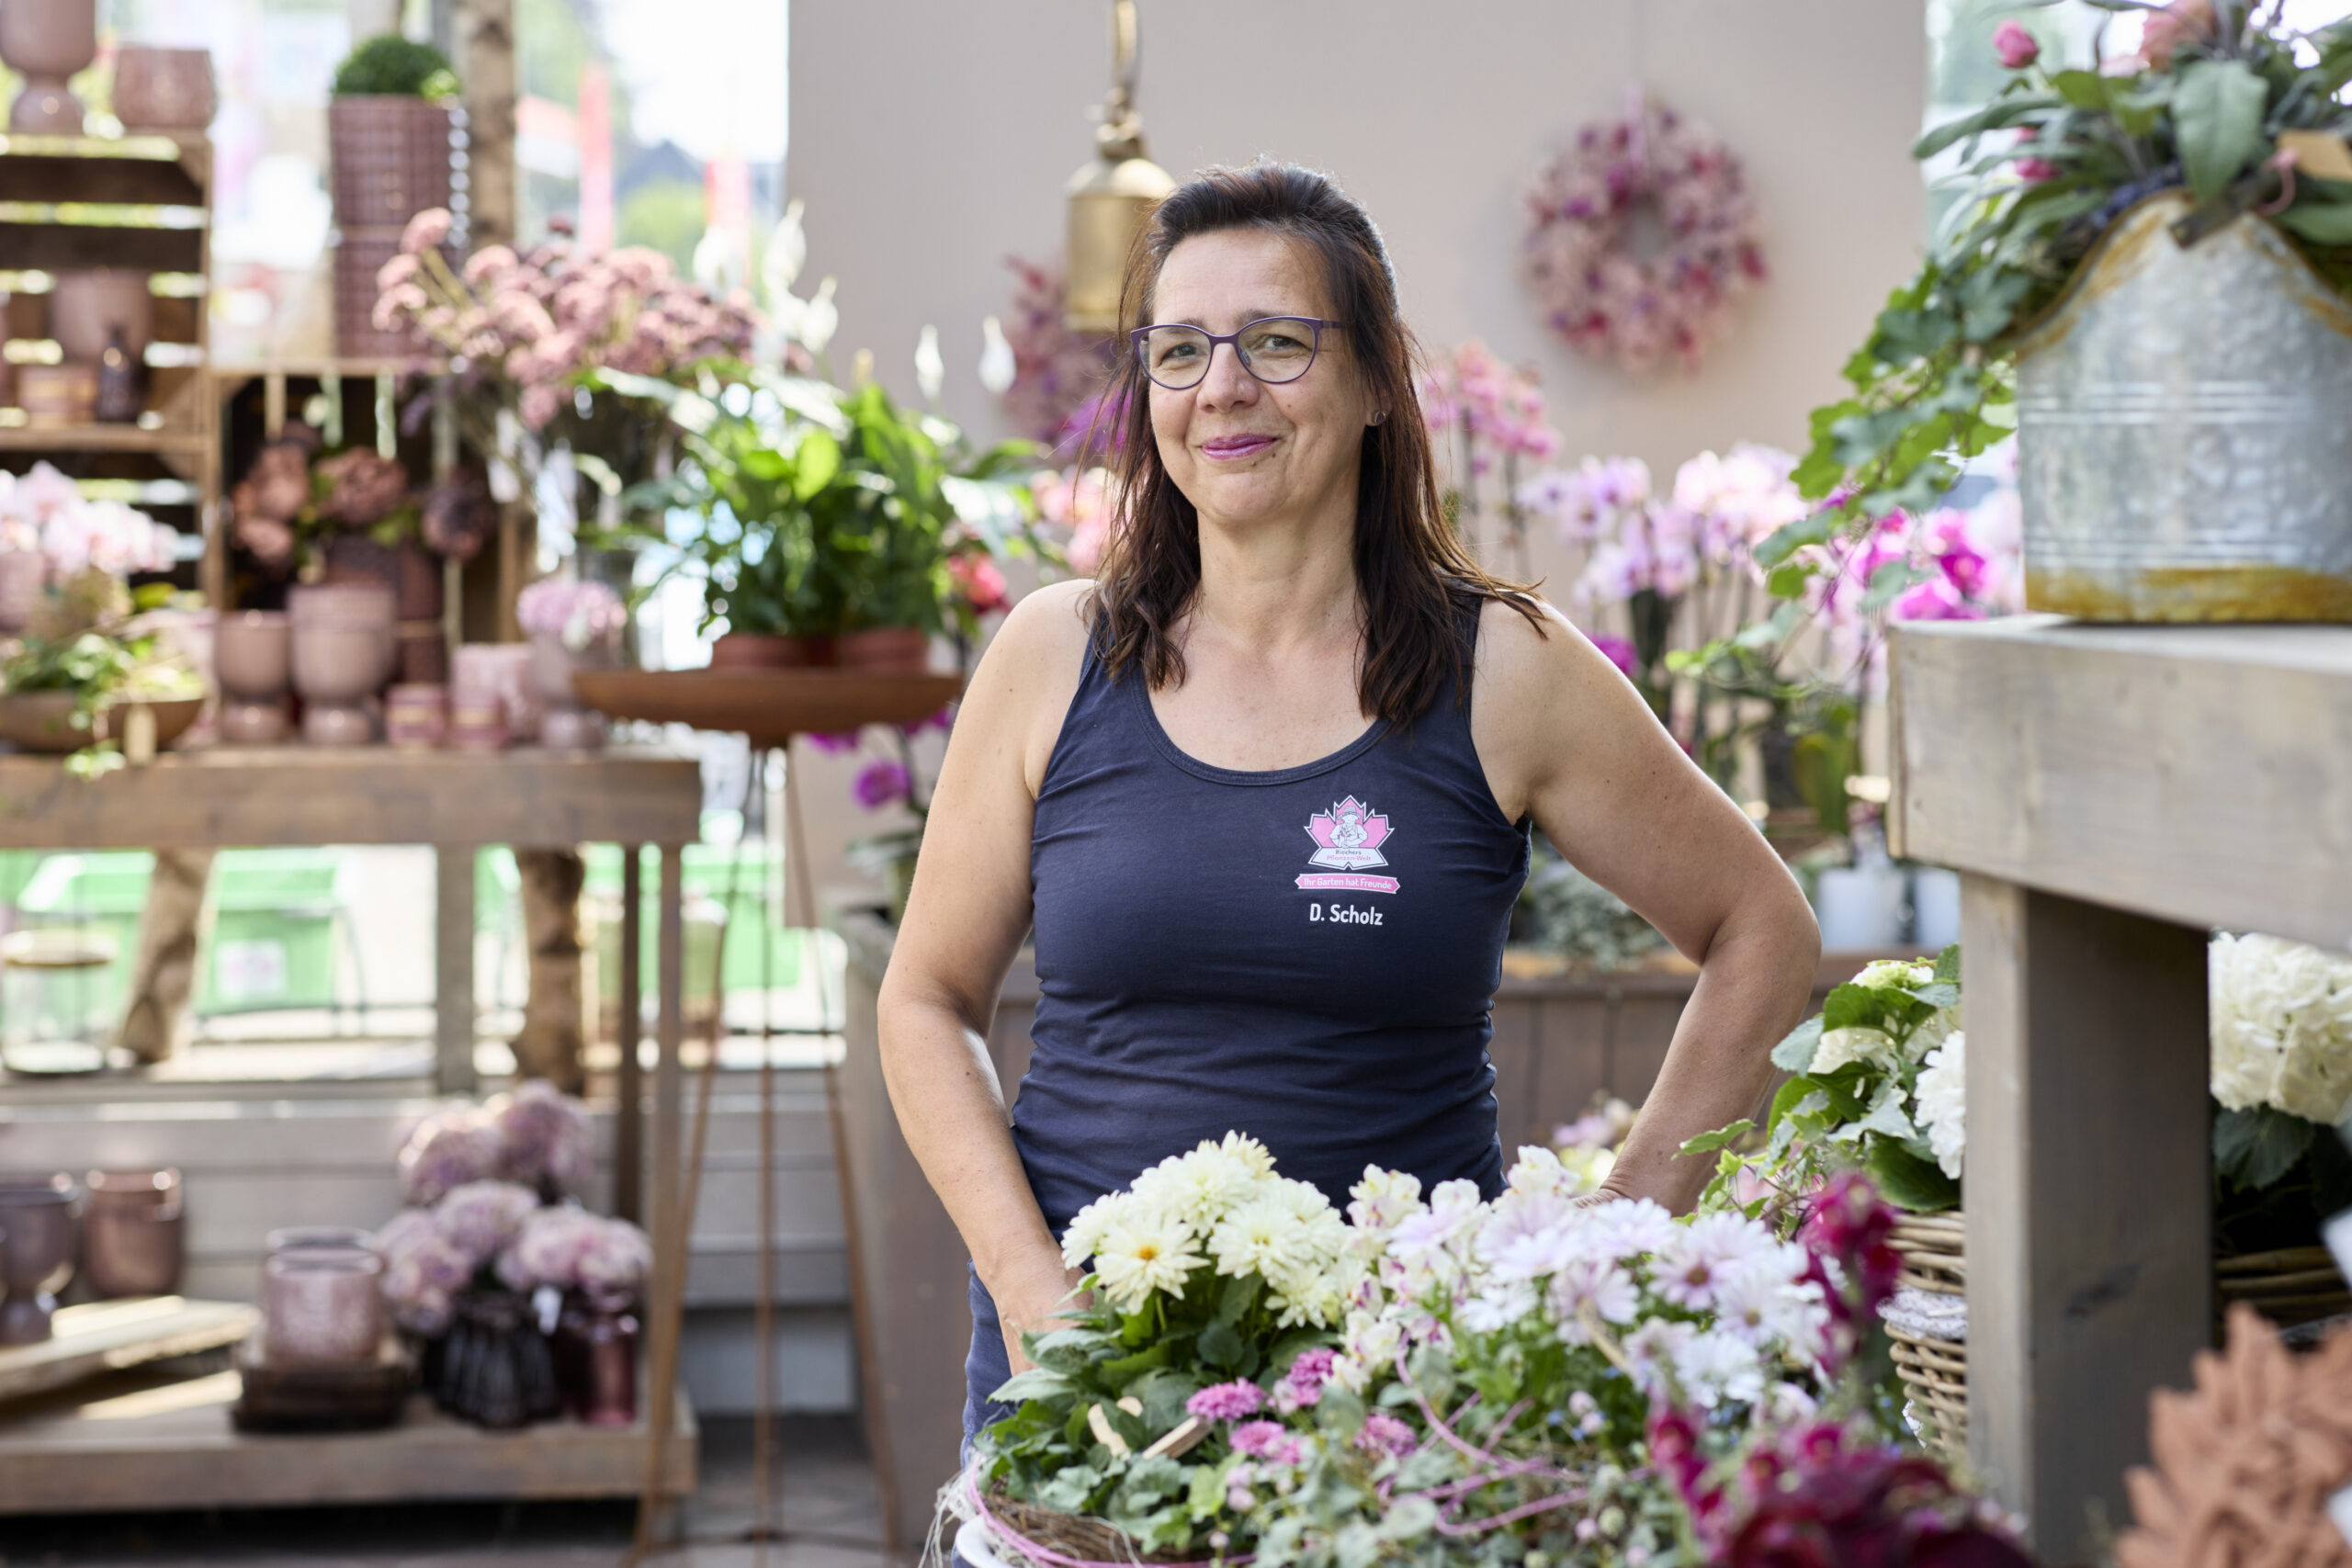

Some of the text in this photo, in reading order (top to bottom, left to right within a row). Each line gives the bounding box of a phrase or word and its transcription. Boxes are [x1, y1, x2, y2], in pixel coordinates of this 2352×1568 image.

[1304, 877, 1392, 889] Ihr Garten hat Freunde
[1309, 903, 1383, 926] D. Scholz
